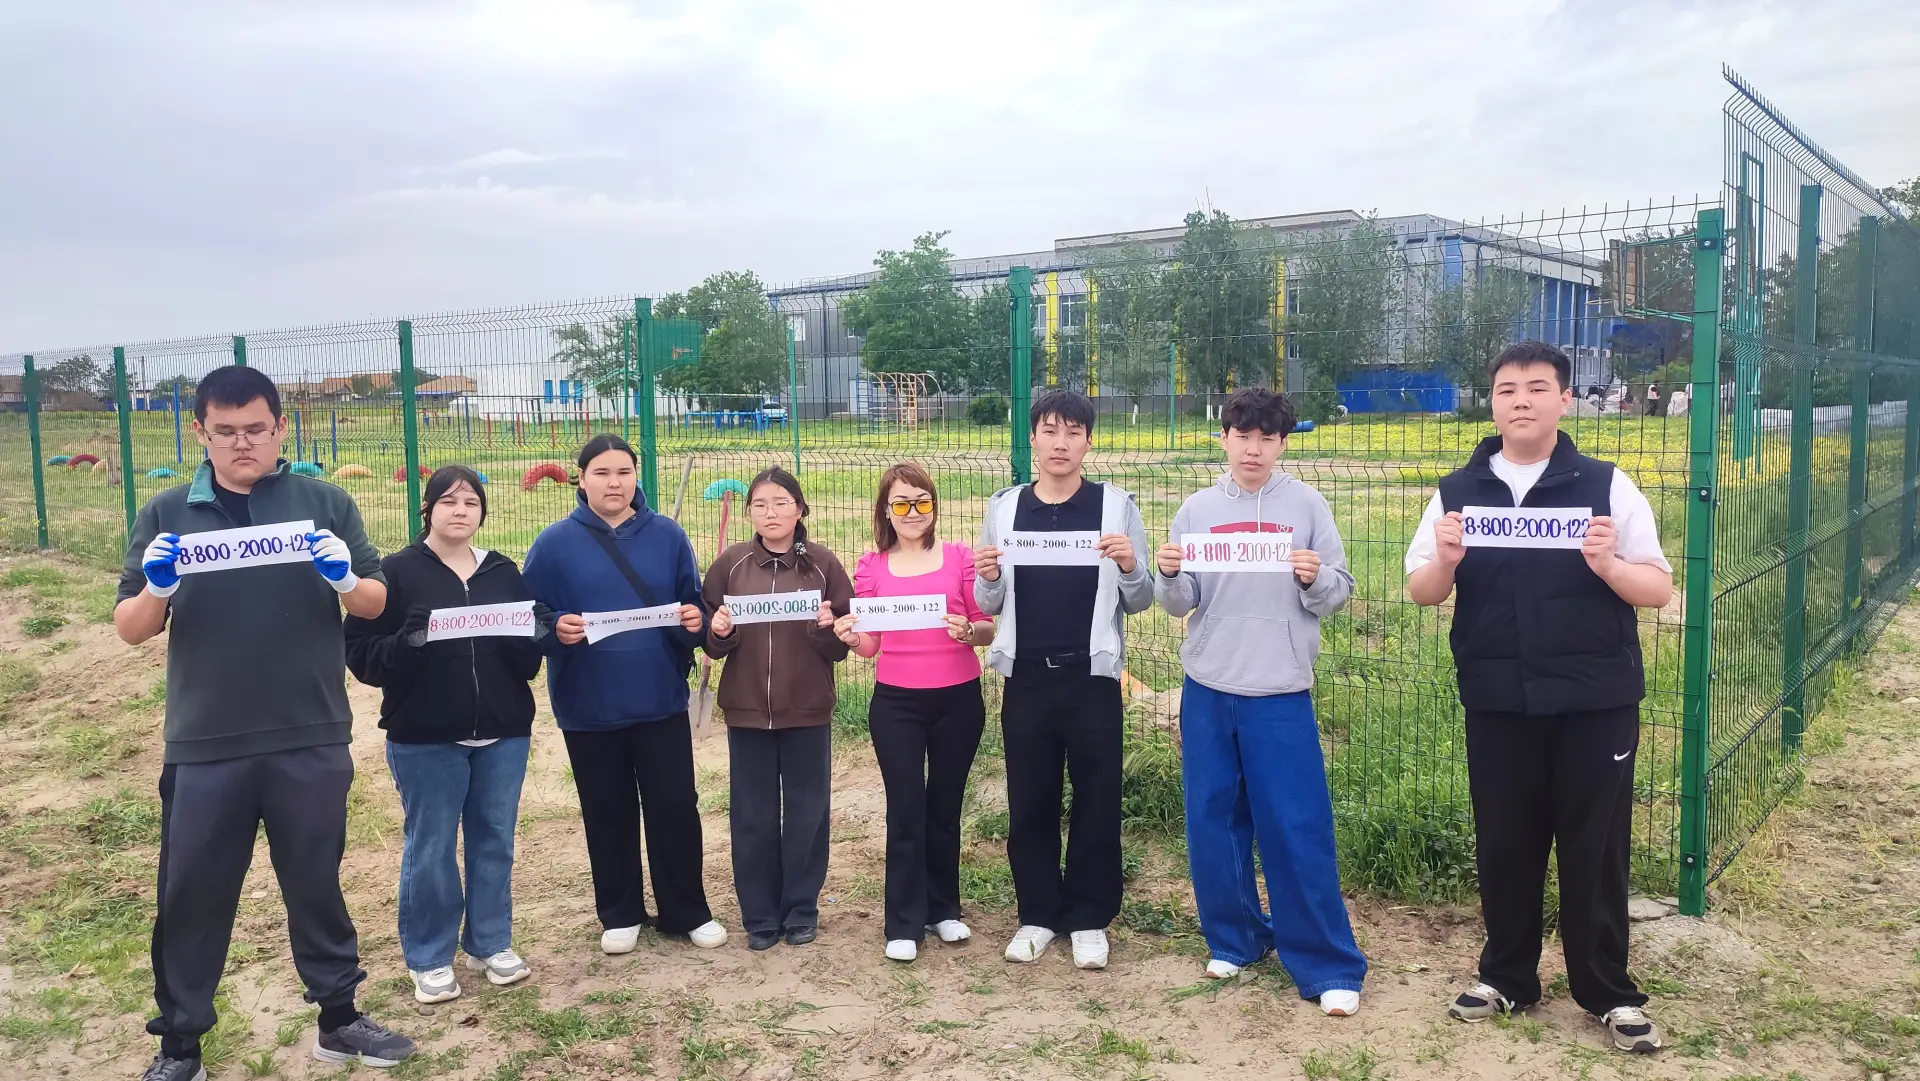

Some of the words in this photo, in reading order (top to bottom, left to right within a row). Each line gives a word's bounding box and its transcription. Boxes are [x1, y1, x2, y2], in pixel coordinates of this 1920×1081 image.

[1016, 539, 1039, 548] 800-
[1042, 539, 1071, 549] 2000-
[1075, 539, 1092, 549] 122
[868, 604, 889, 614] 800-
[893, 603, 919, 613] 2000-
[923, 602, 940, 612] 122
